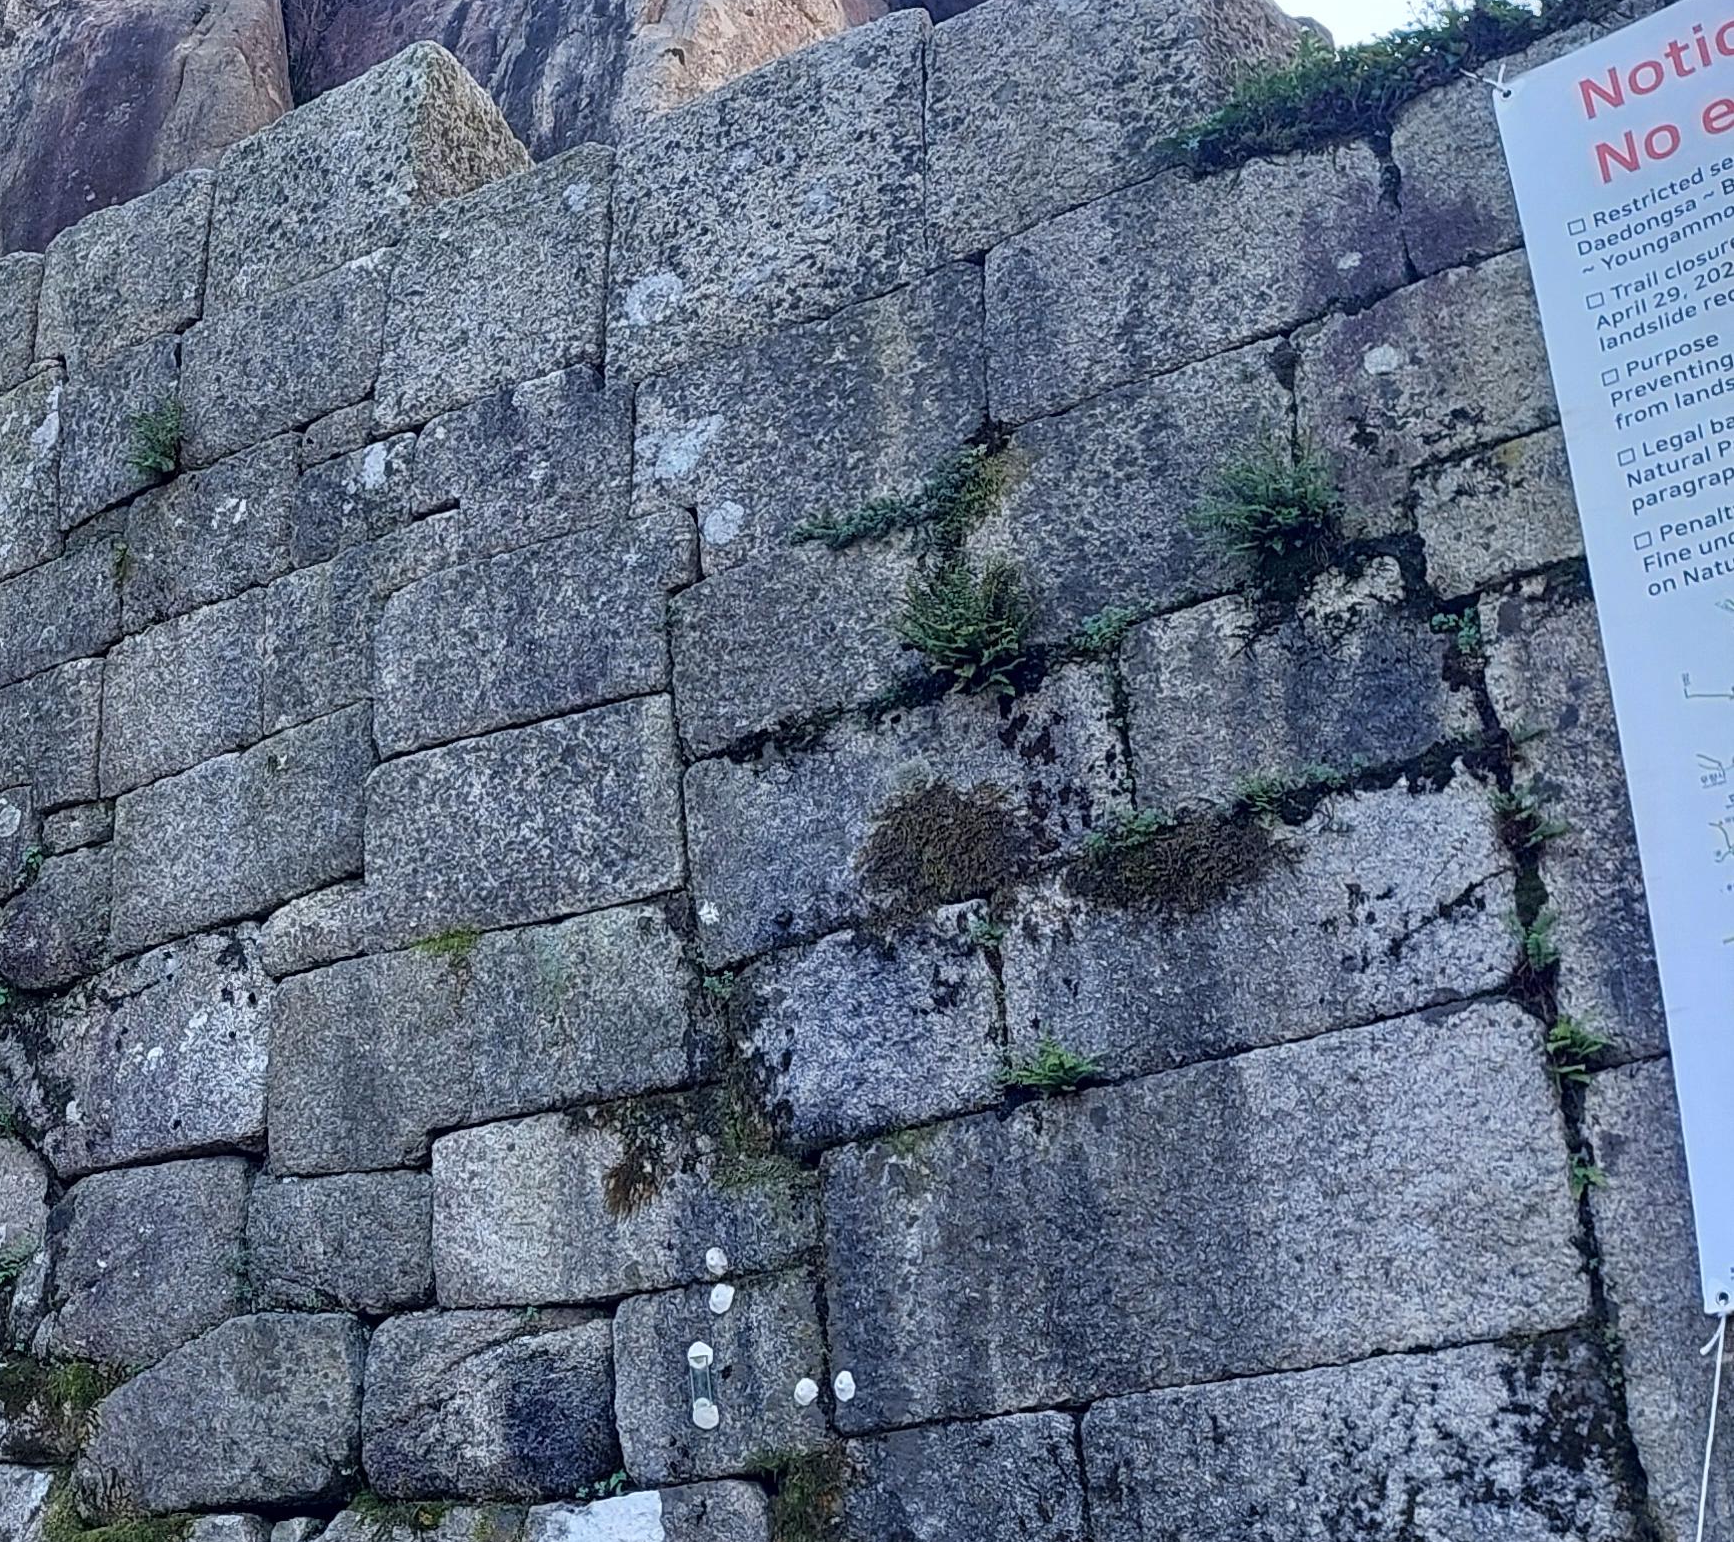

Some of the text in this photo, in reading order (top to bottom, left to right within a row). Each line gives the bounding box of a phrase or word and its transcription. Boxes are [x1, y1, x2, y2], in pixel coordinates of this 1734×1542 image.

[1595, 124, 1681, 184] No
[1593, 157, 1733, 228] Restricted se
[1578, 198, 1697, 256] Daedongsa
[1610, 271, 1659, 300] Trail
[1596, 298, 1647, 331] April
[1653, 286, 1688, 309] 29,
[1599, 305, 1697, 352] landslide
[1626, 334, 1719, 377] Purpose
[1611, 353, 1734, 408] Preventing
[1615, 400, 1669, 430] from
[1642, 423, 1704, 457] Legal
[1626, 445, 1711, 488] Natural
[1643, 547, 1692, 573] Fine
[1648, 577, 1677, 596] on
